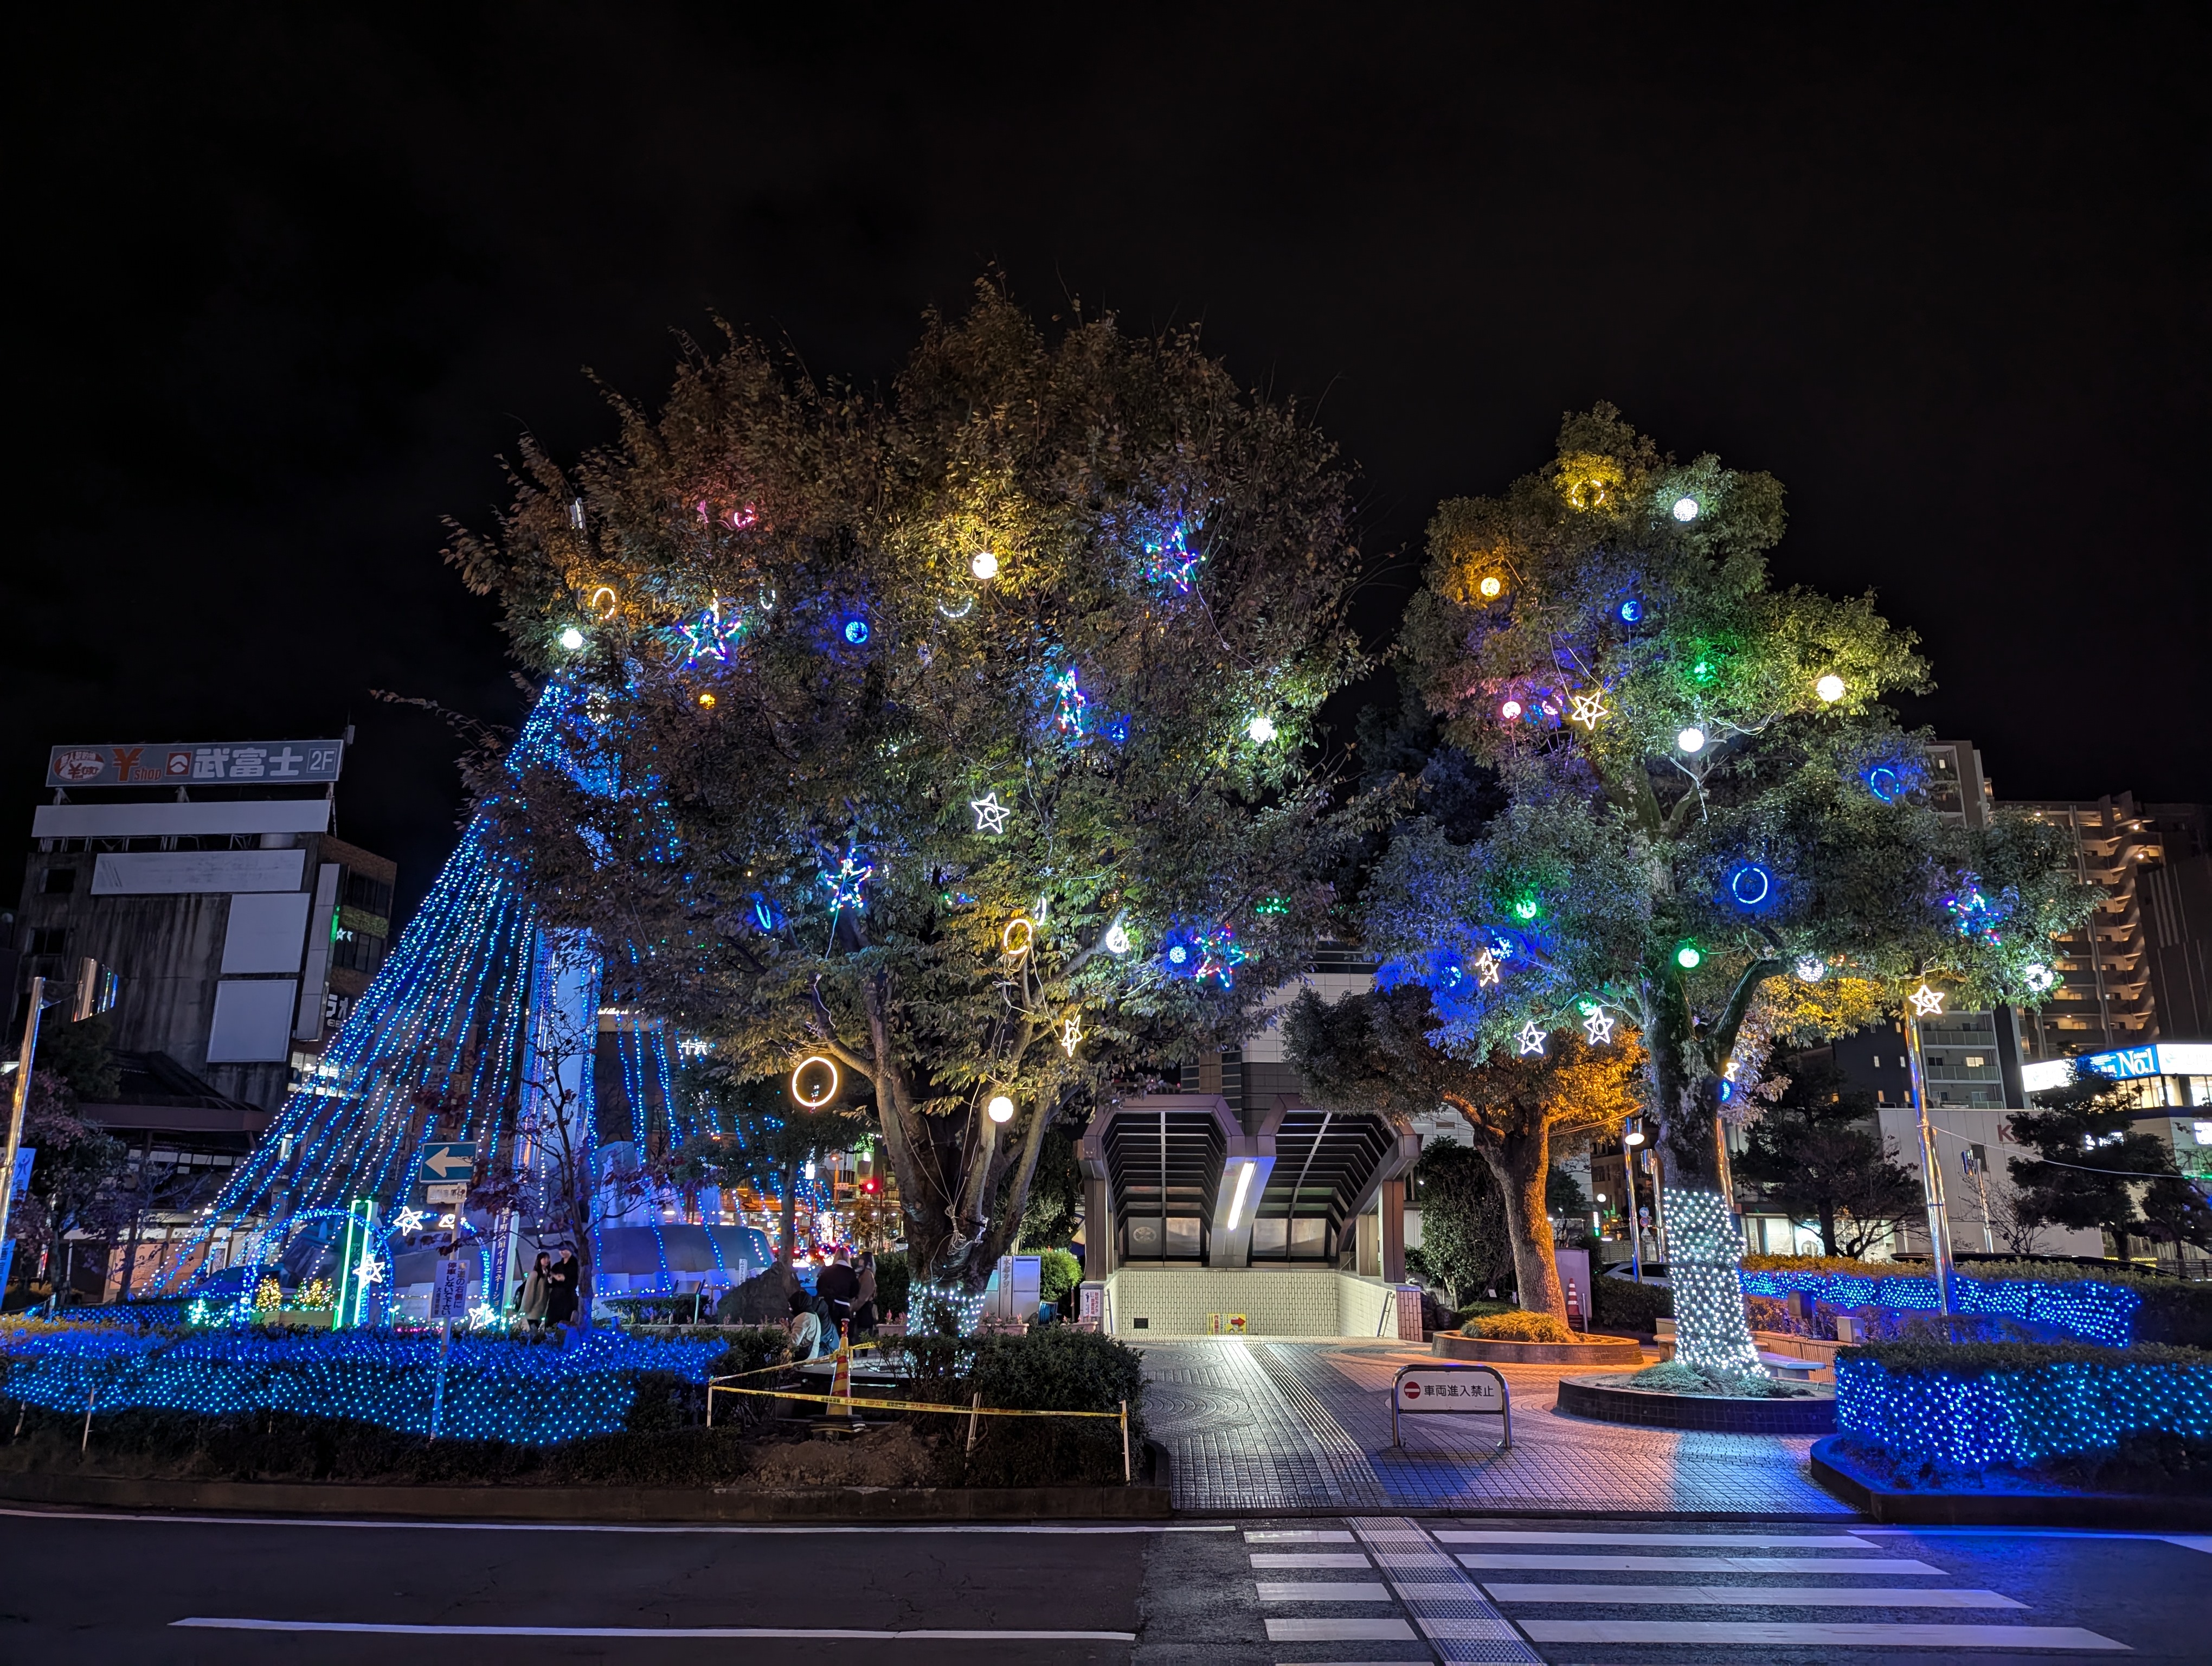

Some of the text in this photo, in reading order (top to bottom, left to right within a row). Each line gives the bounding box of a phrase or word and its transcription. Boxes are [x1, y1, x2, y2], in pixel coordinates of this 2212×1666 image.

[192, 747, 303, 778] 武富士
[310, 751, 335, 771] 2F
[2116, 1047, 2157, 1077] No.1
[492, 1207, 511, 1315] 城下町大垣イルミネーショ
[453, 1262, 467, 1309] 道の右側に
[1424, 1385, 1494, 1397] 車両進入禁止
